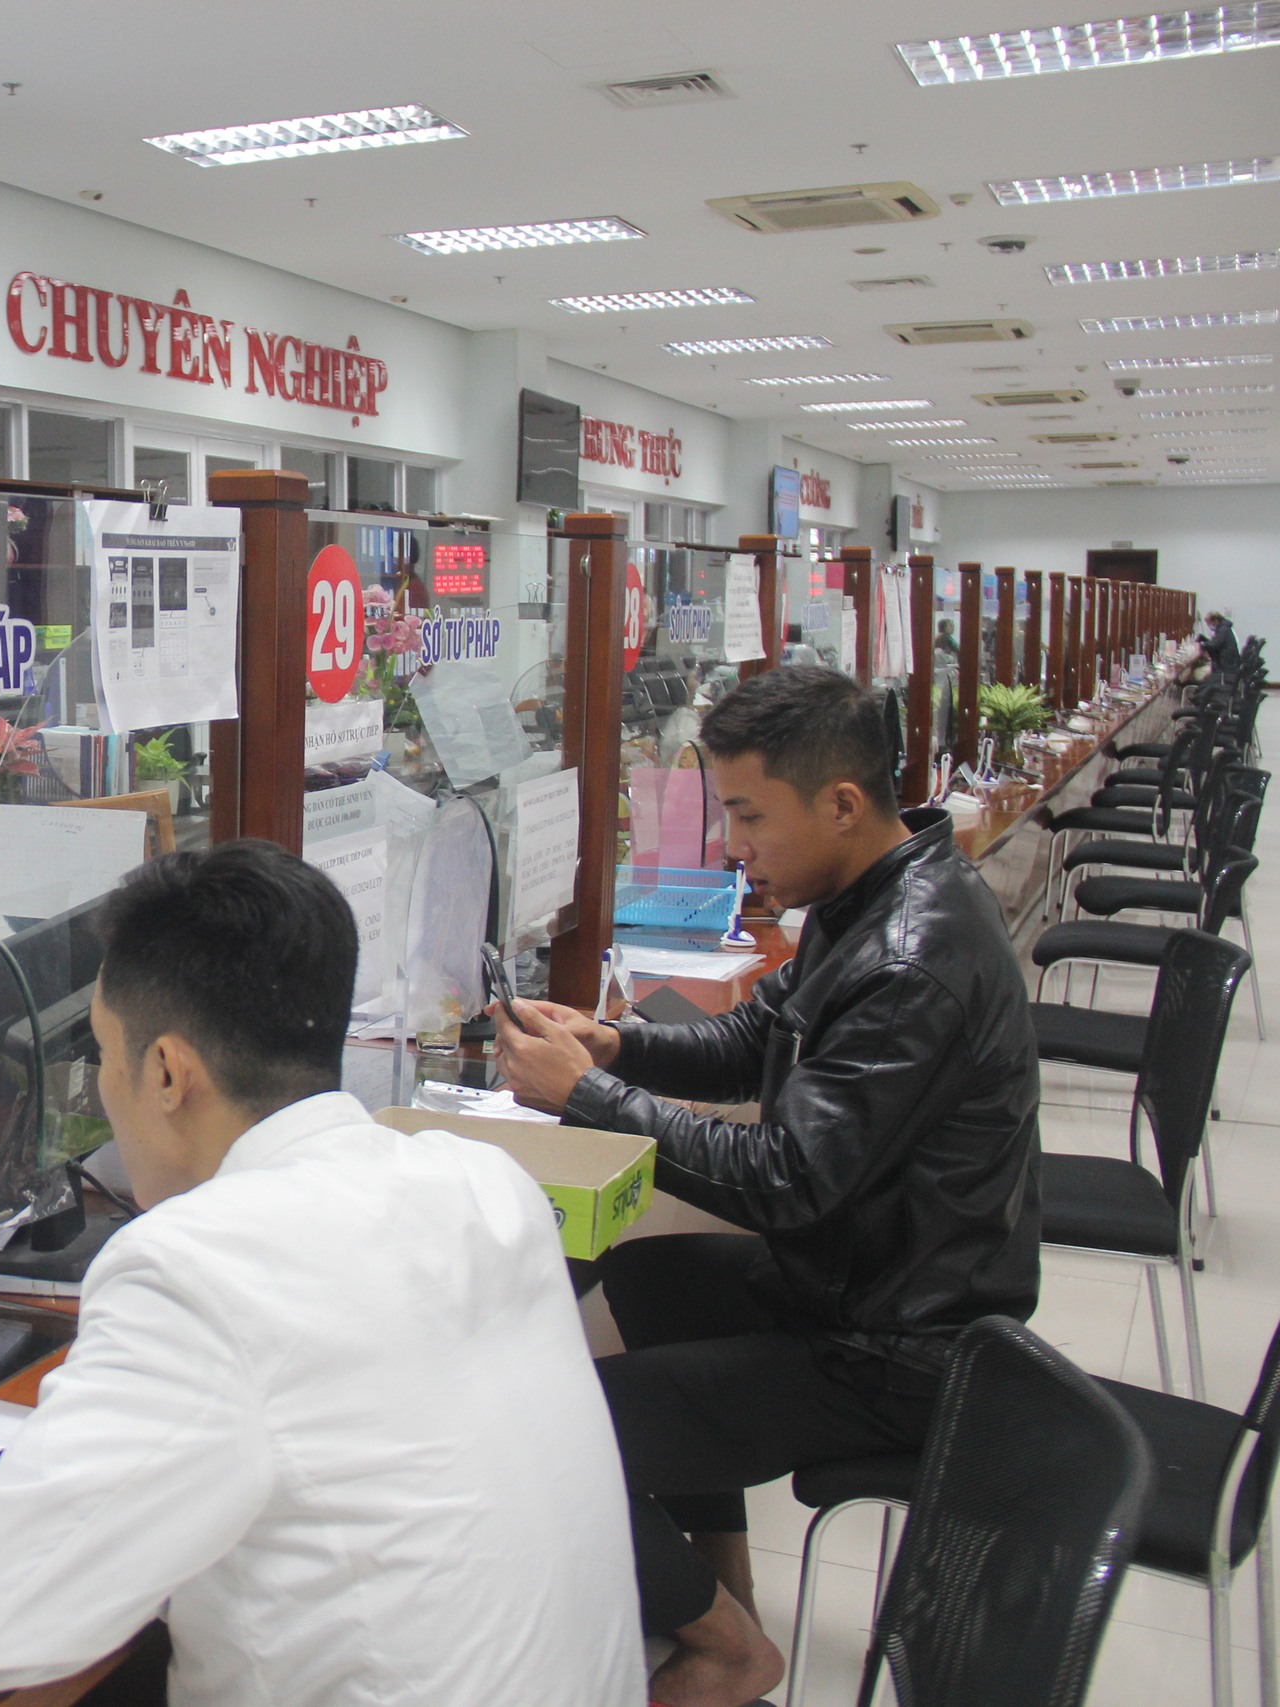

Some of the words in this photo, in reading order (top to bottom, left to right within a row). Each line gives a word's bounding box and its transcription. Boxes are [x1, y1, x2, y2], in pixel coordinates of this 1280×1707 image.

[7, 271, 235, 388] CHUYÊN
[244, 327, 388, 427] NGHIỆP
[579, 415, 636, 468] RUNG
[638, 428, 681, 486] THỰC
[312, 579, 355, 672] 29
[422, 607, 441, 664] SỞ
[445, 616, 464, 660] TƯ
[466, 611, 500, 659] PHÁP
[305, 735, 324, 750] NHẬN
[325, 729, 337, 746] HỒ
[345, 726, 366, 743] TRỰC
[366, 724, 379, 737] TIẾP
